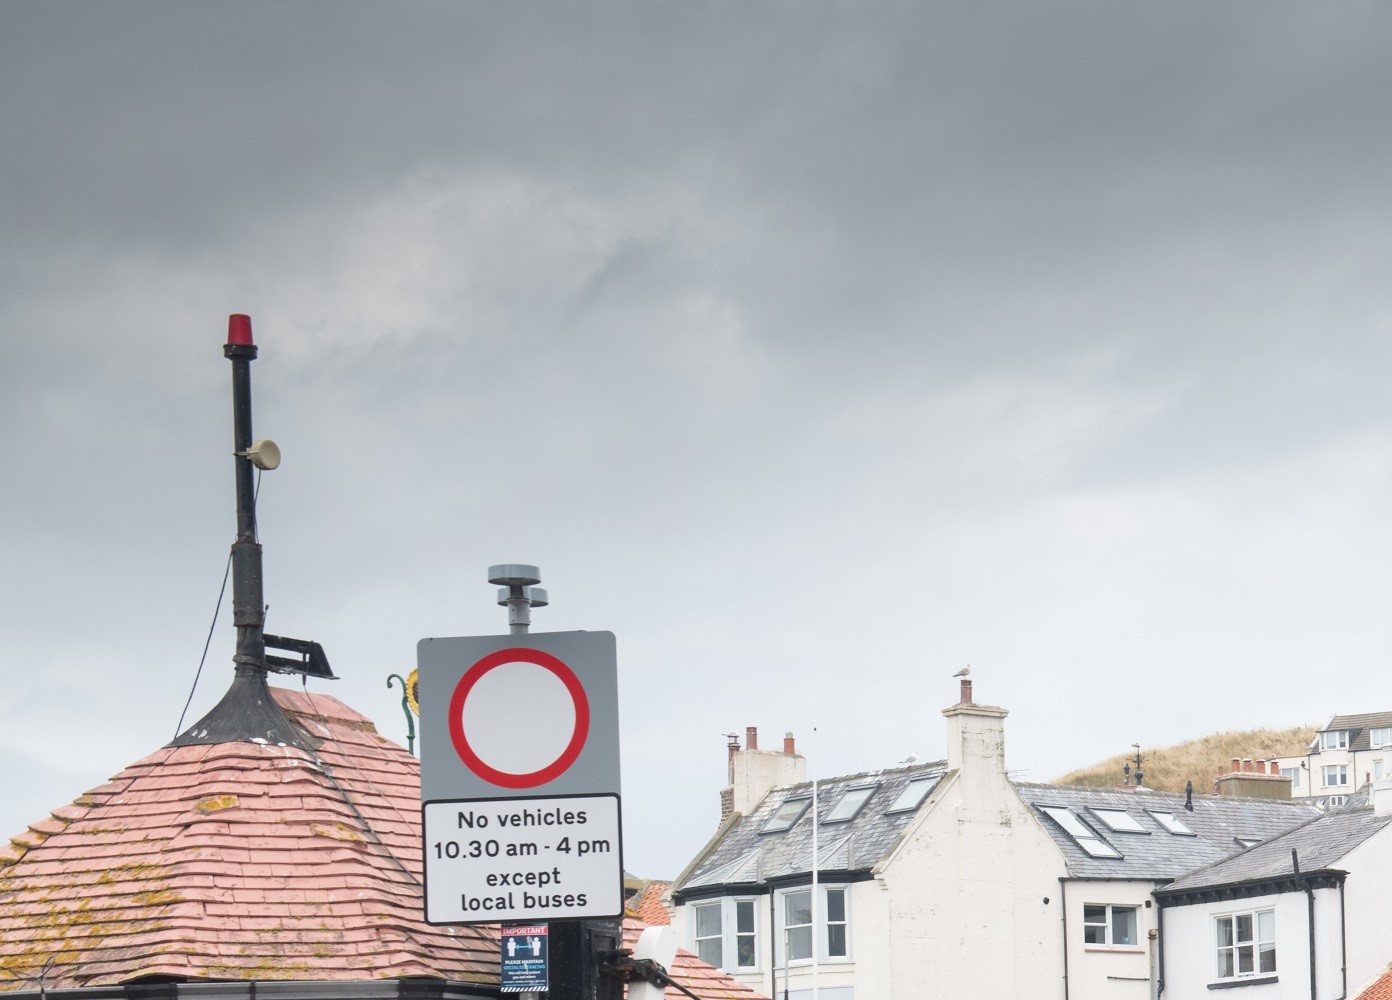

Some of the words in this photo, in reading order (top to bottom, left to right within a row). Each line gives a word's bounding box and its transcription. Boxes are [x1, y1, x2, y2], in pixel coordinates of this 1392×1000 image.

[458, 811, 488, 829] No
[497, 808, 587, 827] vehicles
[434, 839, 499, 859] 10.30
[506, 842, 538, 856] am
[556, 837, 571, 854] 4
[577, 839, 610, 857] pm
[486, 867, 561, 888] except
[461, 892, 515, 911] local
[523, 891, 588, 909] buses
[503, 926, 545, 935] IMPORTANT
